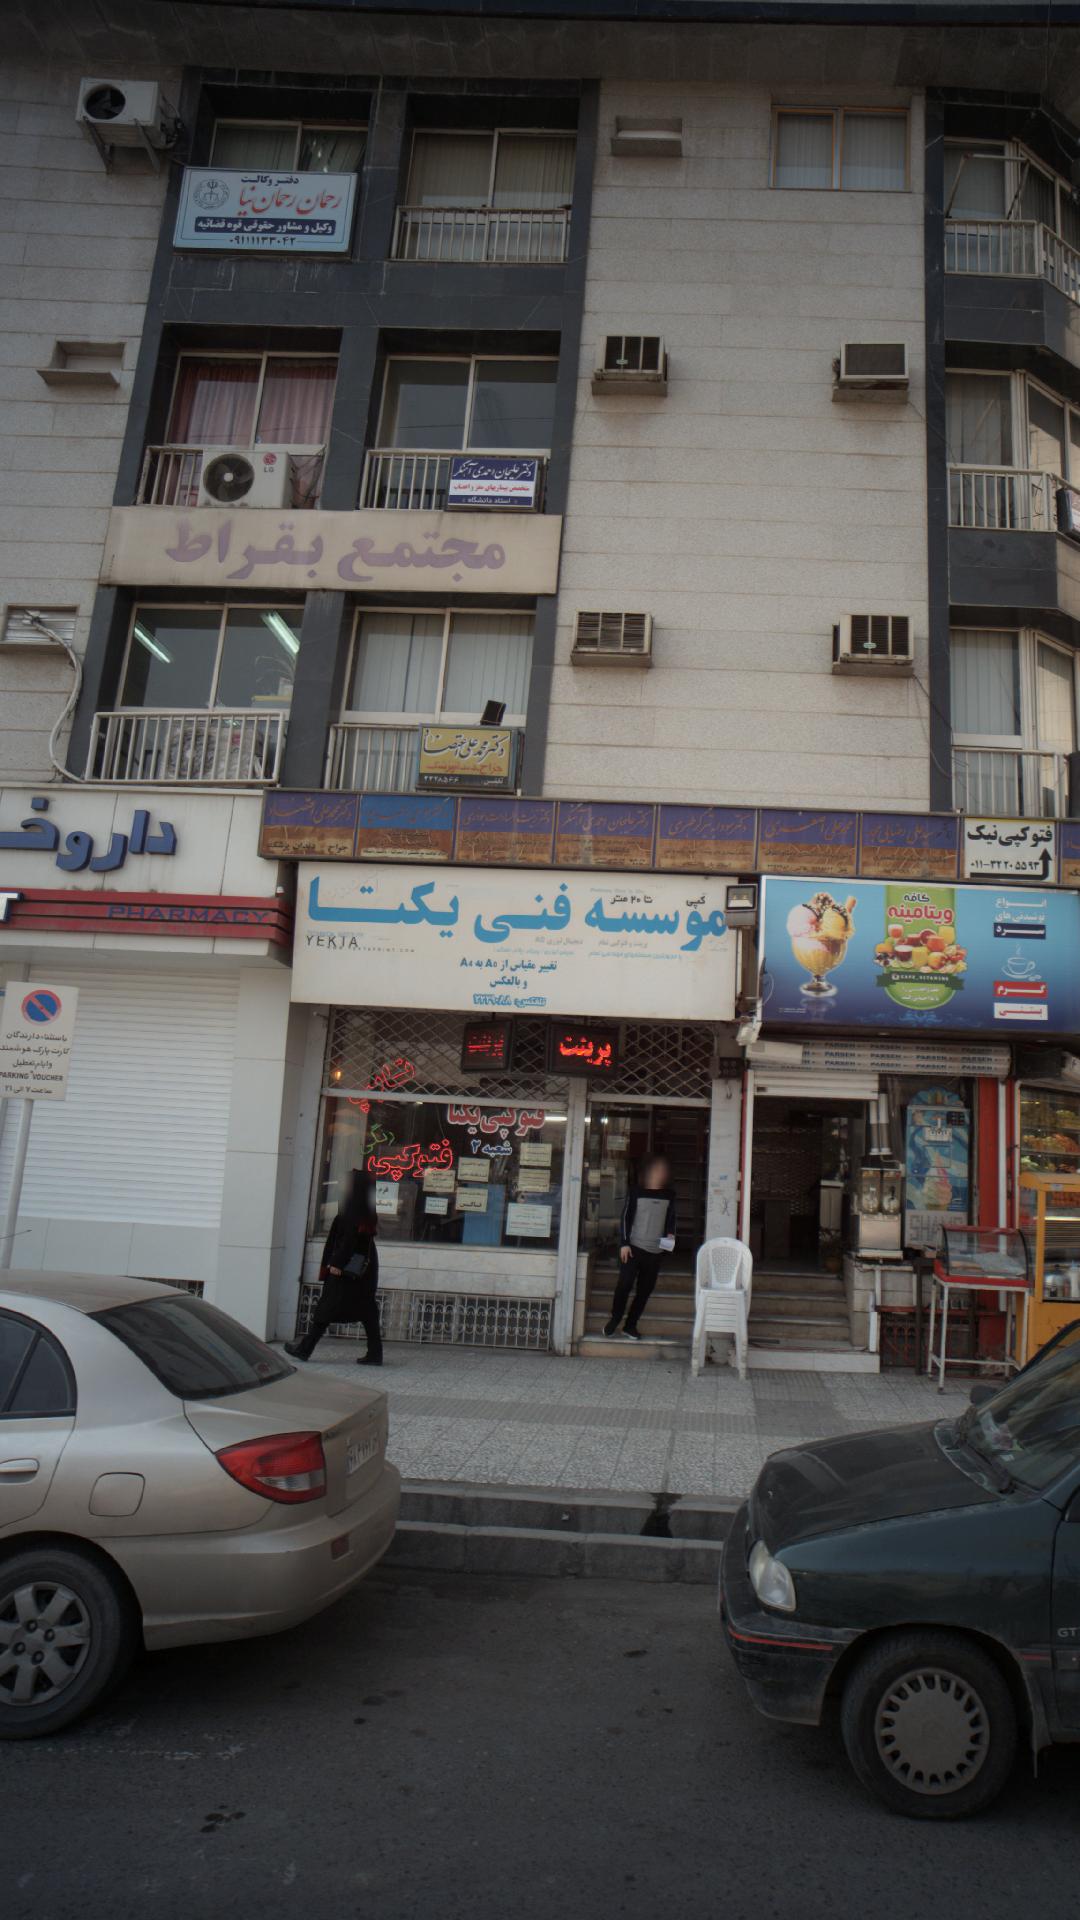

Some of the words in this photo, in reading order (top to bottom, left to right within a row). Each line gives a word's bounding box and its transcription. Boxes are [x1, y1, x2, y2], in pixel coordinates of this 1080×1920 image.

[241, 175, 273, 186] وکالت
[275, 176, 300, 186] دفتر
[296, 189, 342, 215] رحمان
[227, 219, 242, 230] قوه
[244, 220, 274, 232] حقوقی
[276, 221, 302, 233] مشاور
[304, 225, 309, 233] و
[310, 223, 333, 234] وکیل
[514, 461, 534, 479] دکتر
[467, 496, 492, 504] دانشگاه
[165, 518, 324, 580] بقراط
[336, 530, 506, 583] مجتمع
[479, 735, 509, 763] دکتر
[0, 797, 177, 873] داروخ
[967, 825, 998, 844] نیک
[609, 894, 628, 905] متر
[686, 896, 706, 910] کپی
[903, 892, 930, 903] کافه
[995, 896, 1048, 909] انواع
[308, 876, 459, 938] یکتا
[473, 882, 571, 944] فنی
[106, 904, 270, 924] PHARMACY
[888, 904, 955, 924] ویتامینه
[584, 896, 729, 952] موسسه
[995, 925, 1045, 936] سرد
[475, 959, 483, 970] به
[500, 959, 508, 971] از
[509, 959, 536, 972] مقیاس
[538, 960, 558, 973] تغییر
[489, 975, 521, 988] بالعکس
[522, 980, 528, 989] و
[996, 984, 1046, 995] گرم
[32, 1046, 50, 1056] پارک
[51, 1047, 70, 1057] کارت
[32, 1072, 64, 1082] VOUCHER
[470, 1138, 482, 1154] ۲
[481, 1139, 513, 1158] شعبه
